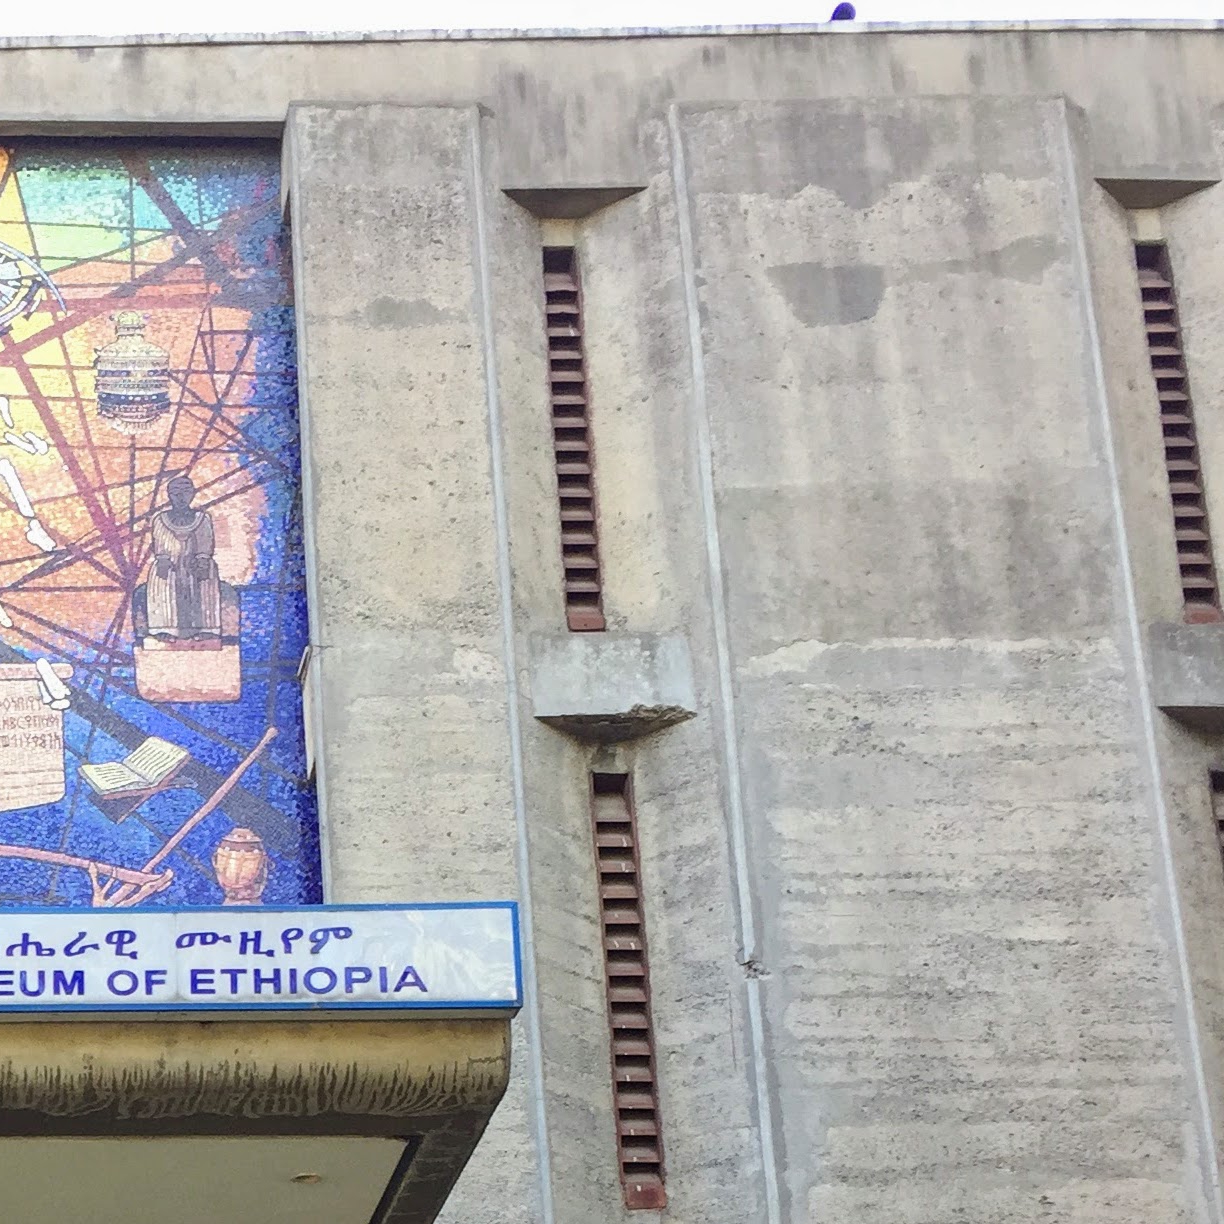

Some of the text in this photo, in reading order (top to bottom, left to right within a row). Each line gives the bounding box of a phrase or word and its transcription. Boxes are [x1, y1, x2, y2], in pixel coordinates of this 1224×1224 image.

[175, 926, 353, 958] ሙዚየም
[107, 969, 168, 996] OF
[190, 965, 428, 995] ETHIOPIA
